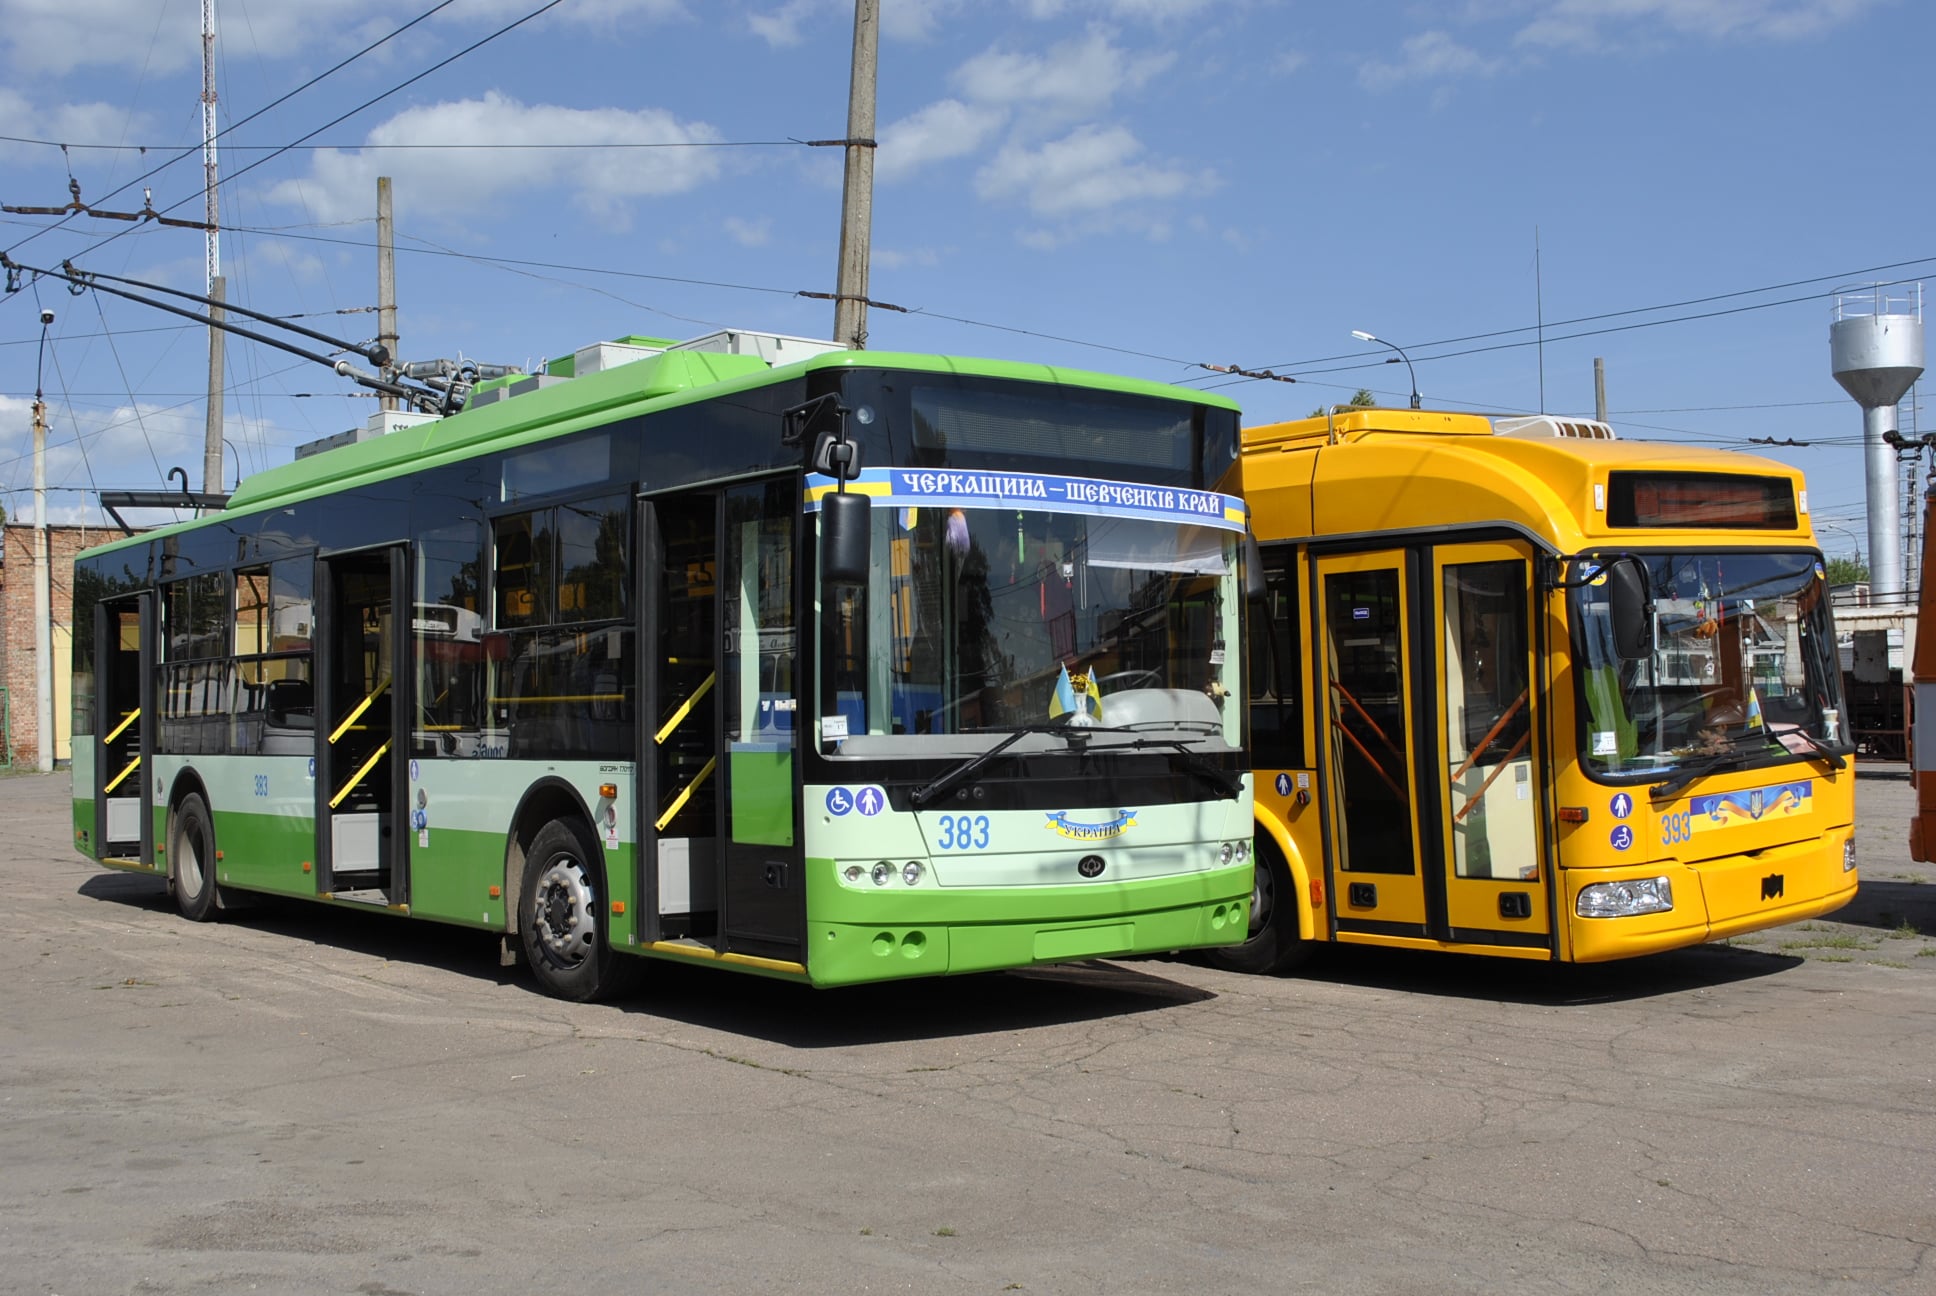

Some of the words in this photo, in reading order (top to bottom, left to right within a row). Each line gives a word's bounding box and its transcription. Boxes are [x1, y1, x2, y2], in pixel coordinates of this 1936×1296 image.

[902, 472, 1047, 499] ЧЕРКАЩИНА
[1066, 482, 1174, 509] ШЕВЧЕНКІВ
[1178, 493, 1220, 515] КРАЙ
[254, 774, 268, 797] 383
[938, 815, 990, 850] 383
[1064, 823, 1122, 839] УКРАЇНА
[1661, 811, 1691, 845] 393
